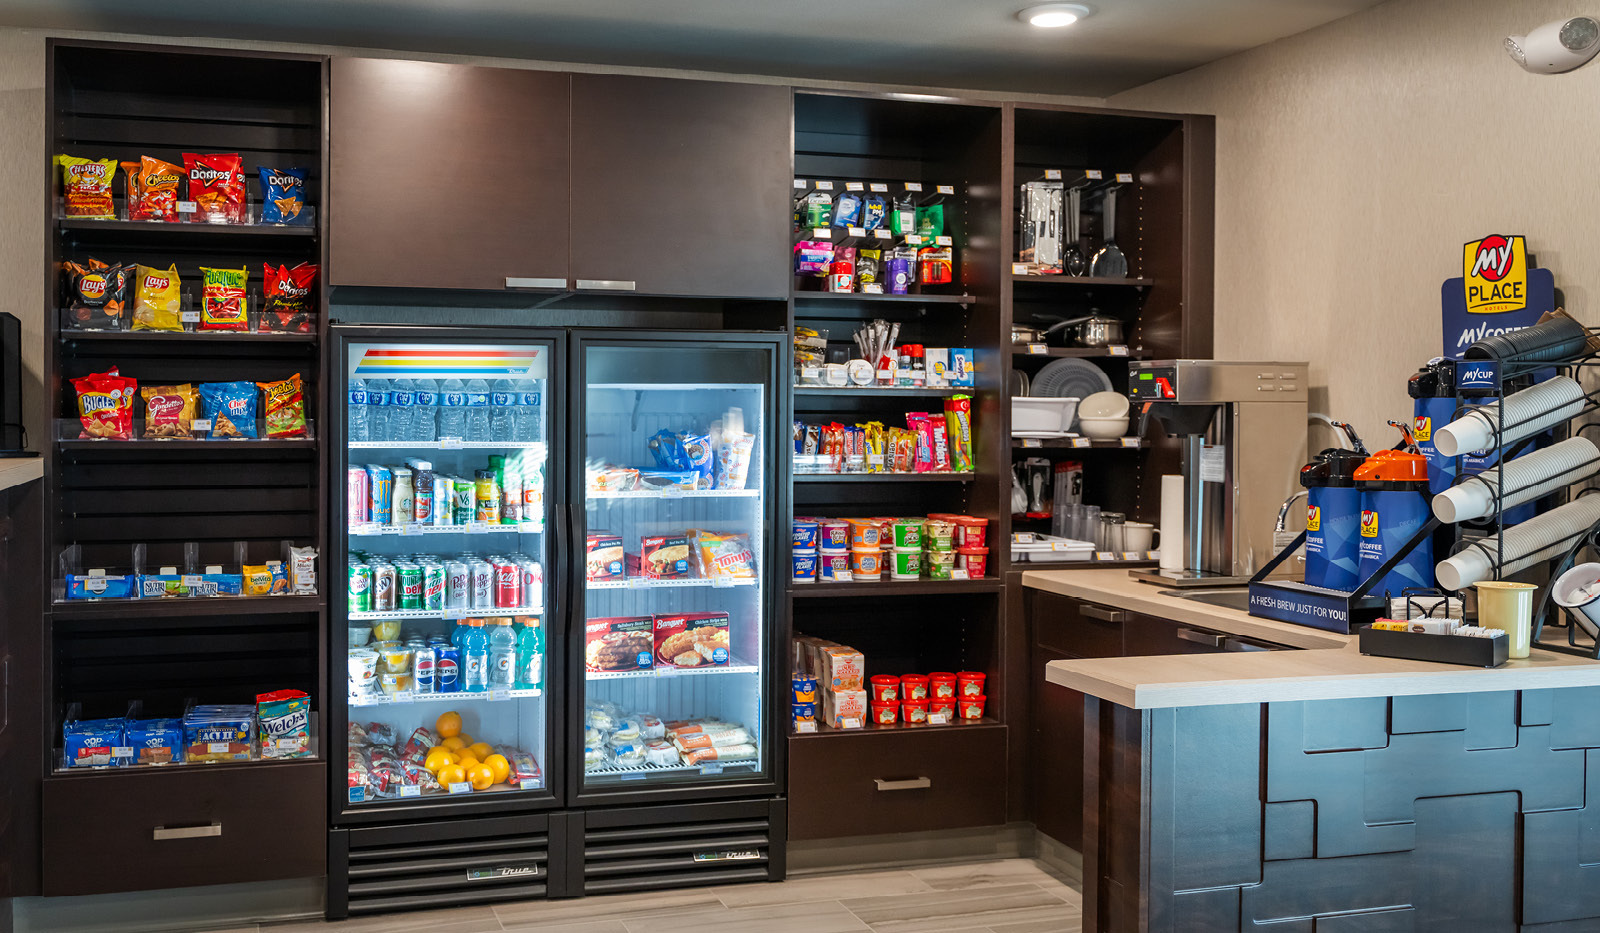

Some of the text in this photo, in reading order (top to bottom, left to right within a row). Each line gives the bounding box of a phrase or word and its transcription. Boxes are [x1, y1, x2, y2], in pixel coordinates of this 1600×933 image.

[145, 174, 180, 187] Cheetos
[190, 169, 231, 181] Doritos
[269, 175, 303, 187] Doritos
[1471, 236, 1514, 278] MY
[81, 280, 106, 293] Lay's
[145, 275, 169, 289] Lay's
[278, 280, 308, 296] Doritos
[1469, 282, 1523, 302] PLACE
[1463, 368, 1494, 381] MYCUP
[82, 395, 117, 415] BUGLES
[228, 398, 249, 409] Chex
[956, 410, 970, 442] AIRHEADS
[933, 425, 948, 465] Twizzlers
[1363, 511, 1374, 525] MY
[715, 548, 753, 569] Tony's
[1250, 595, 1347, 621] A FRESH BREW JUST FOR YOU!
[656, 617, 685, 630] Banquet
[261, 711, 306, 734] Welch's
[84, 737, 103, 748] POP
[145, 737, 165, 748] POP
[202, 730, 234, 741] ACT II
